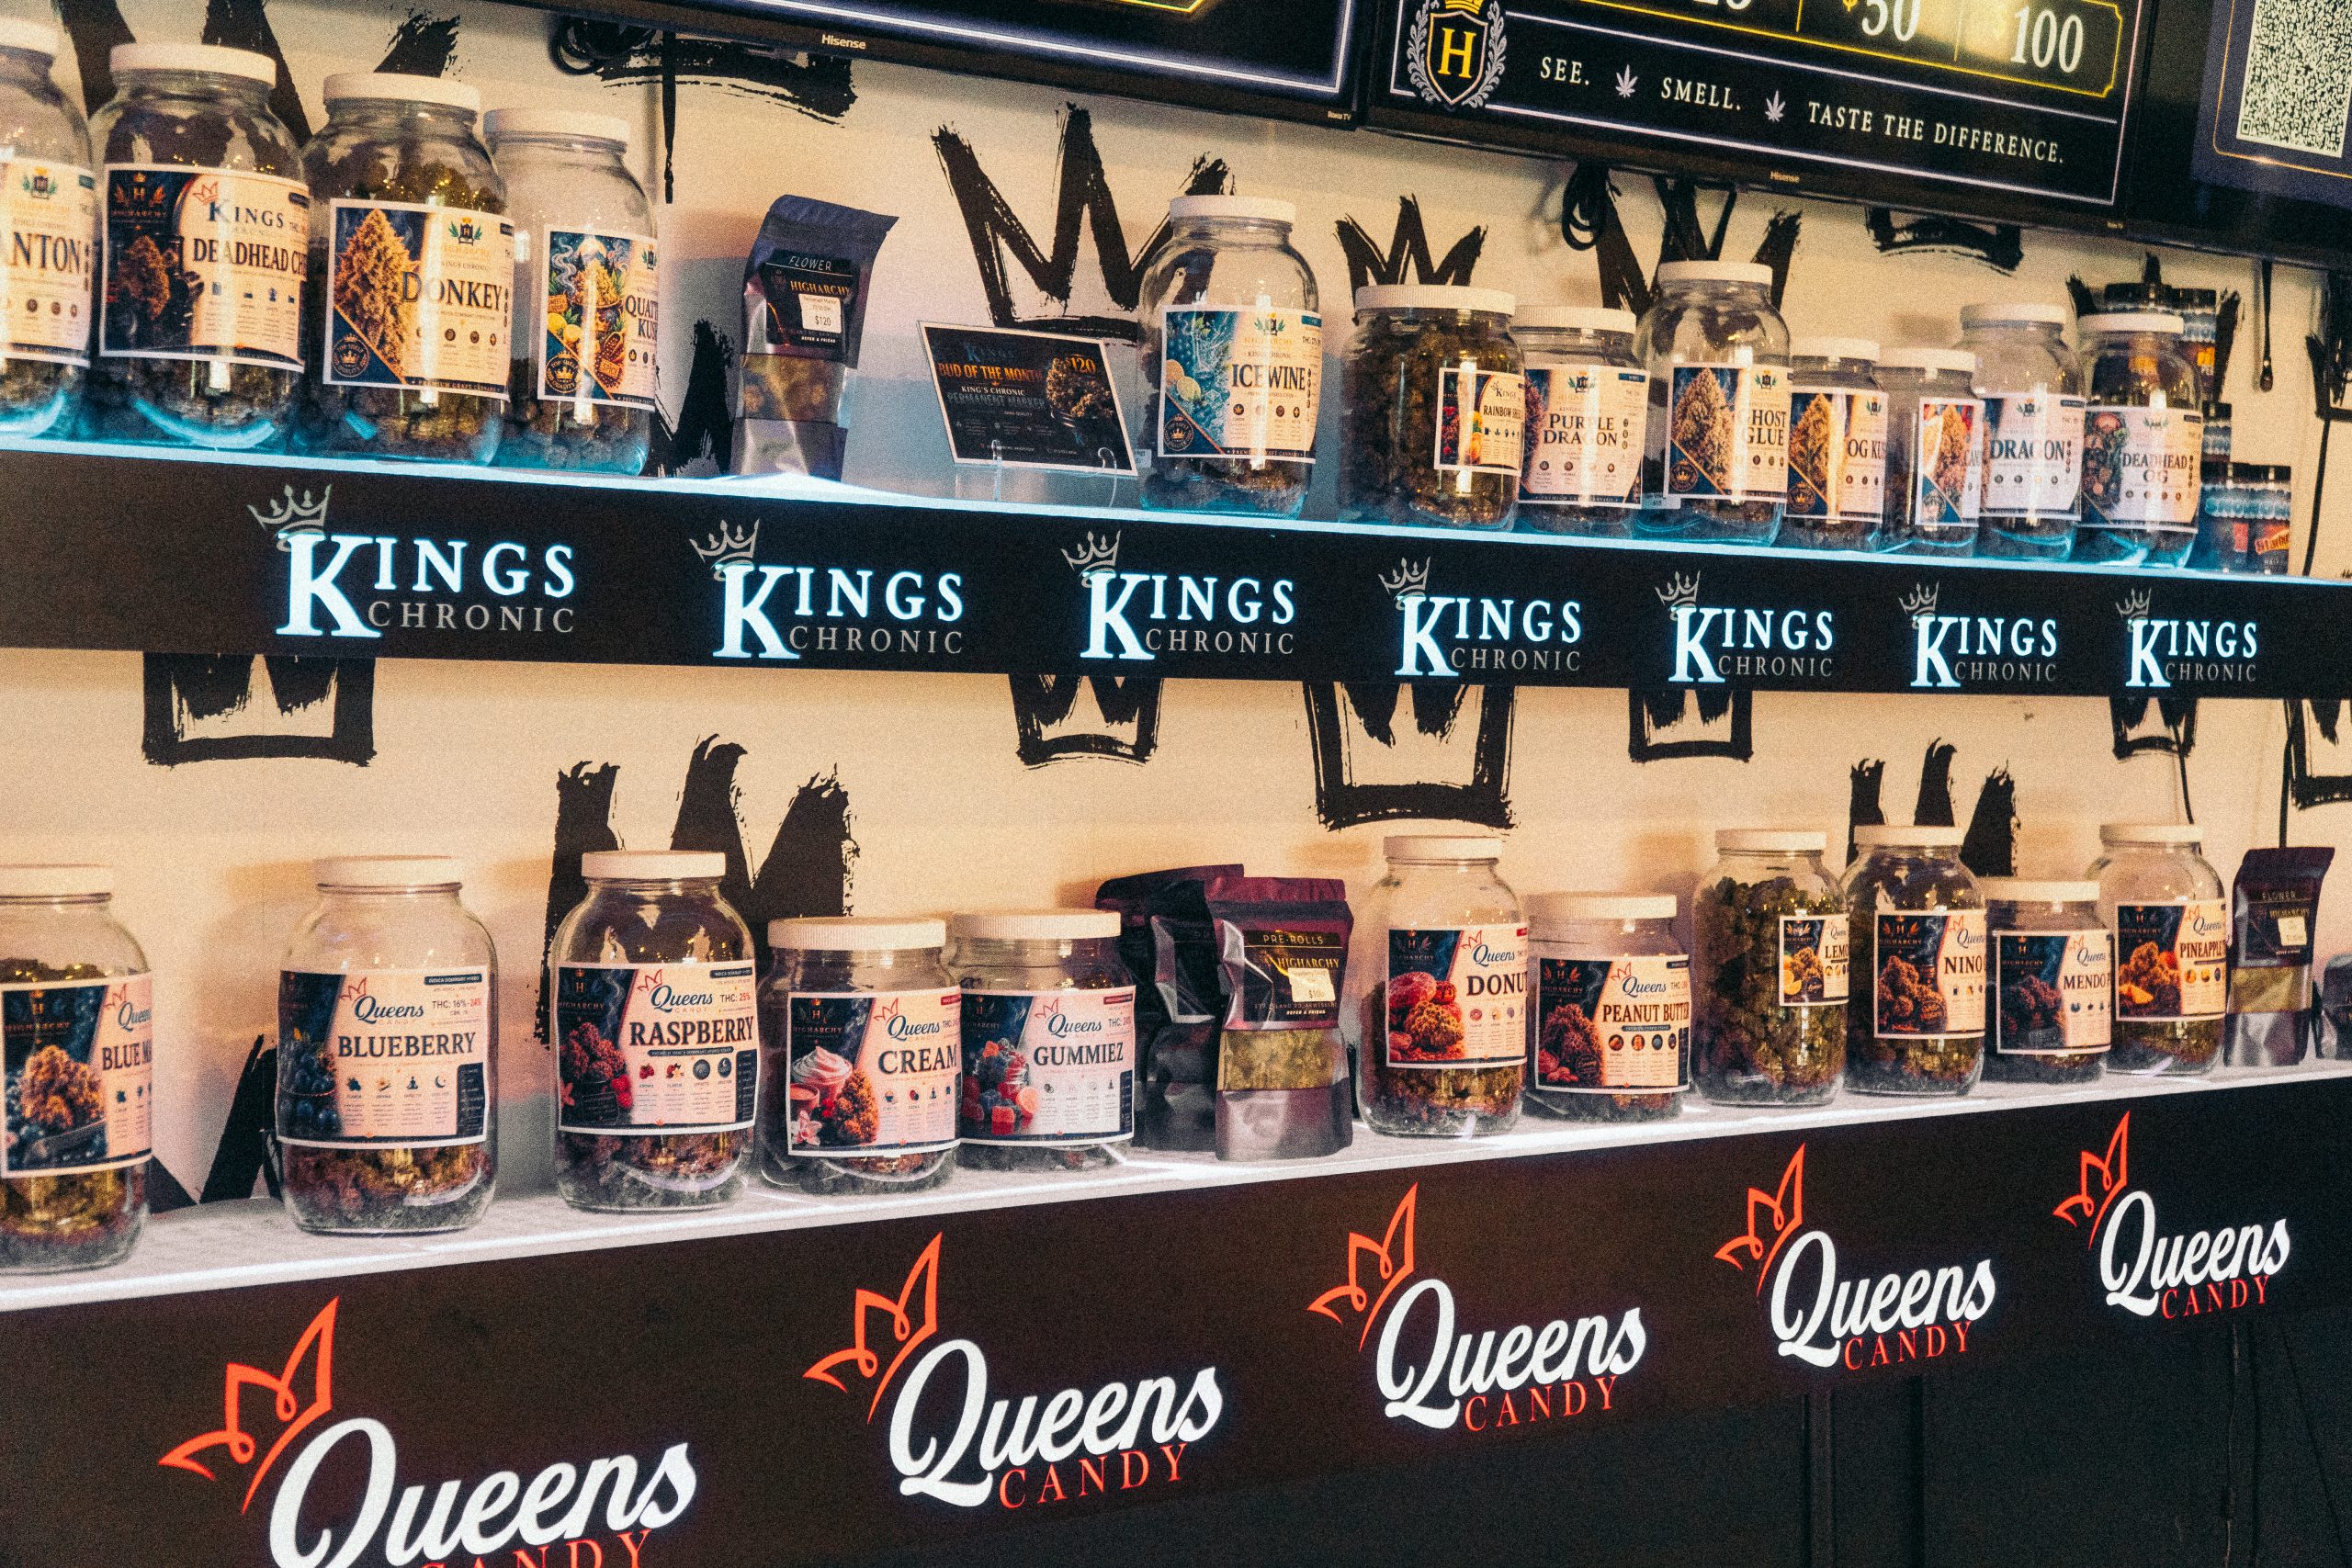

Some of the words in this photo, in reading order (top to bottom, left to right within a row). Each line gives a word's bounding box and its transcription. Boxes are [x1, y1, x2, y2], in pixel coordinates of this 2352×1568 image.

[821, 33, 866, 50] Hisense
[1438, 28, 1476, 79] H
[2010, 8, 2085, 73] 100
[1540, 56, 1590, 85] SEE.
[1660, 77, 1742, 111] SMELL.
[1808, 101, 1873, 133] TASTE
[1884, 114, 1925, 141] THE
[1933, 124, 2064, 165] DIFFERENCE.
[1770, 171, 1800, 183] Hisense
[8, 231, 82, 276] NTON
[193, 238, 288, 274] DEADHEAD
[788, 255, 831, 272] FLOWER
[401, 271, 503, 311] DONKEY
[790, 280, 852, 296] HIGHARCHY
[964, 364, 978, 378] OF
[980, 366, 1002, 380] THE
[1544, 429, 1618, 446] DRAON
[1549, 413, 1614, 431] PURLE
[1848, 438, 1869, 458] OG
[276, 533, 575, 637] KINGS
[368, 600, 575, 633] CHRONIC
[712, 563, 964, 660] KINGS
[1080, 571, 1295, 660] KINGS
[788, 625, 964, 655] CHRONIC
[1145, 627, 1295, 655] CHRONIC
[1394, 595, 1582, 677] KINGS
[1668, 606, 1834, 683] KINGS
[1910, 615, 2057, 688] KINGS
[1450, 647, 1581, 672] CHRONIC
[1717, 654, 1833, 678] CHRONIC
[2125, 620, 2258, 688] KINGS
[1954, 660, 2057, 682] CHRONIC
[2165, 662, 2257, 683] CHRONIC
[1262, 933, 1324, 945] PRE-ROLLS
[1277, 957, 1340, 969] HIGHARCHY
[1473, 944, 1515, 967] Queens
[650, 985, 714, 1013] Queens
[1623, 976, 1667, 998] Queens
[354, 995, 424, 1025] Queens
[1602, 1003, 1661, 1023] PEANUT
[629, 1015, 754, 1047] RASPBERRY
[887, 1015, 941, 1043] Queens
[1047, 1013, 1102, 1039] Queens
[102, 1043, 140, 1071] BLUE
[338, 1032, 477, 1058] BLUEBERRY
[878, 1043, 958, 1075] CREAM
[1034, 1042, 1124, 1066] GUMMIEZ
[2098, 1190, 2291, 1316] Queens
[1770, 1230, 1996, 1368] Queens
[2161, 1275, 2270, 1320] CANDY
[1376, 1278, 1647, 1429] Queens
[1844, 1320, 1973, 1371] CANDY
[1464, 1374, 1618, 1432] CANDY
[889, 1338, 1224, 1507] Queens
[999, 1442, 1188, 1509] CANDY
[269, 1417, 697, 1568] Queens
[421, 1529, 651, 1568] NDY
